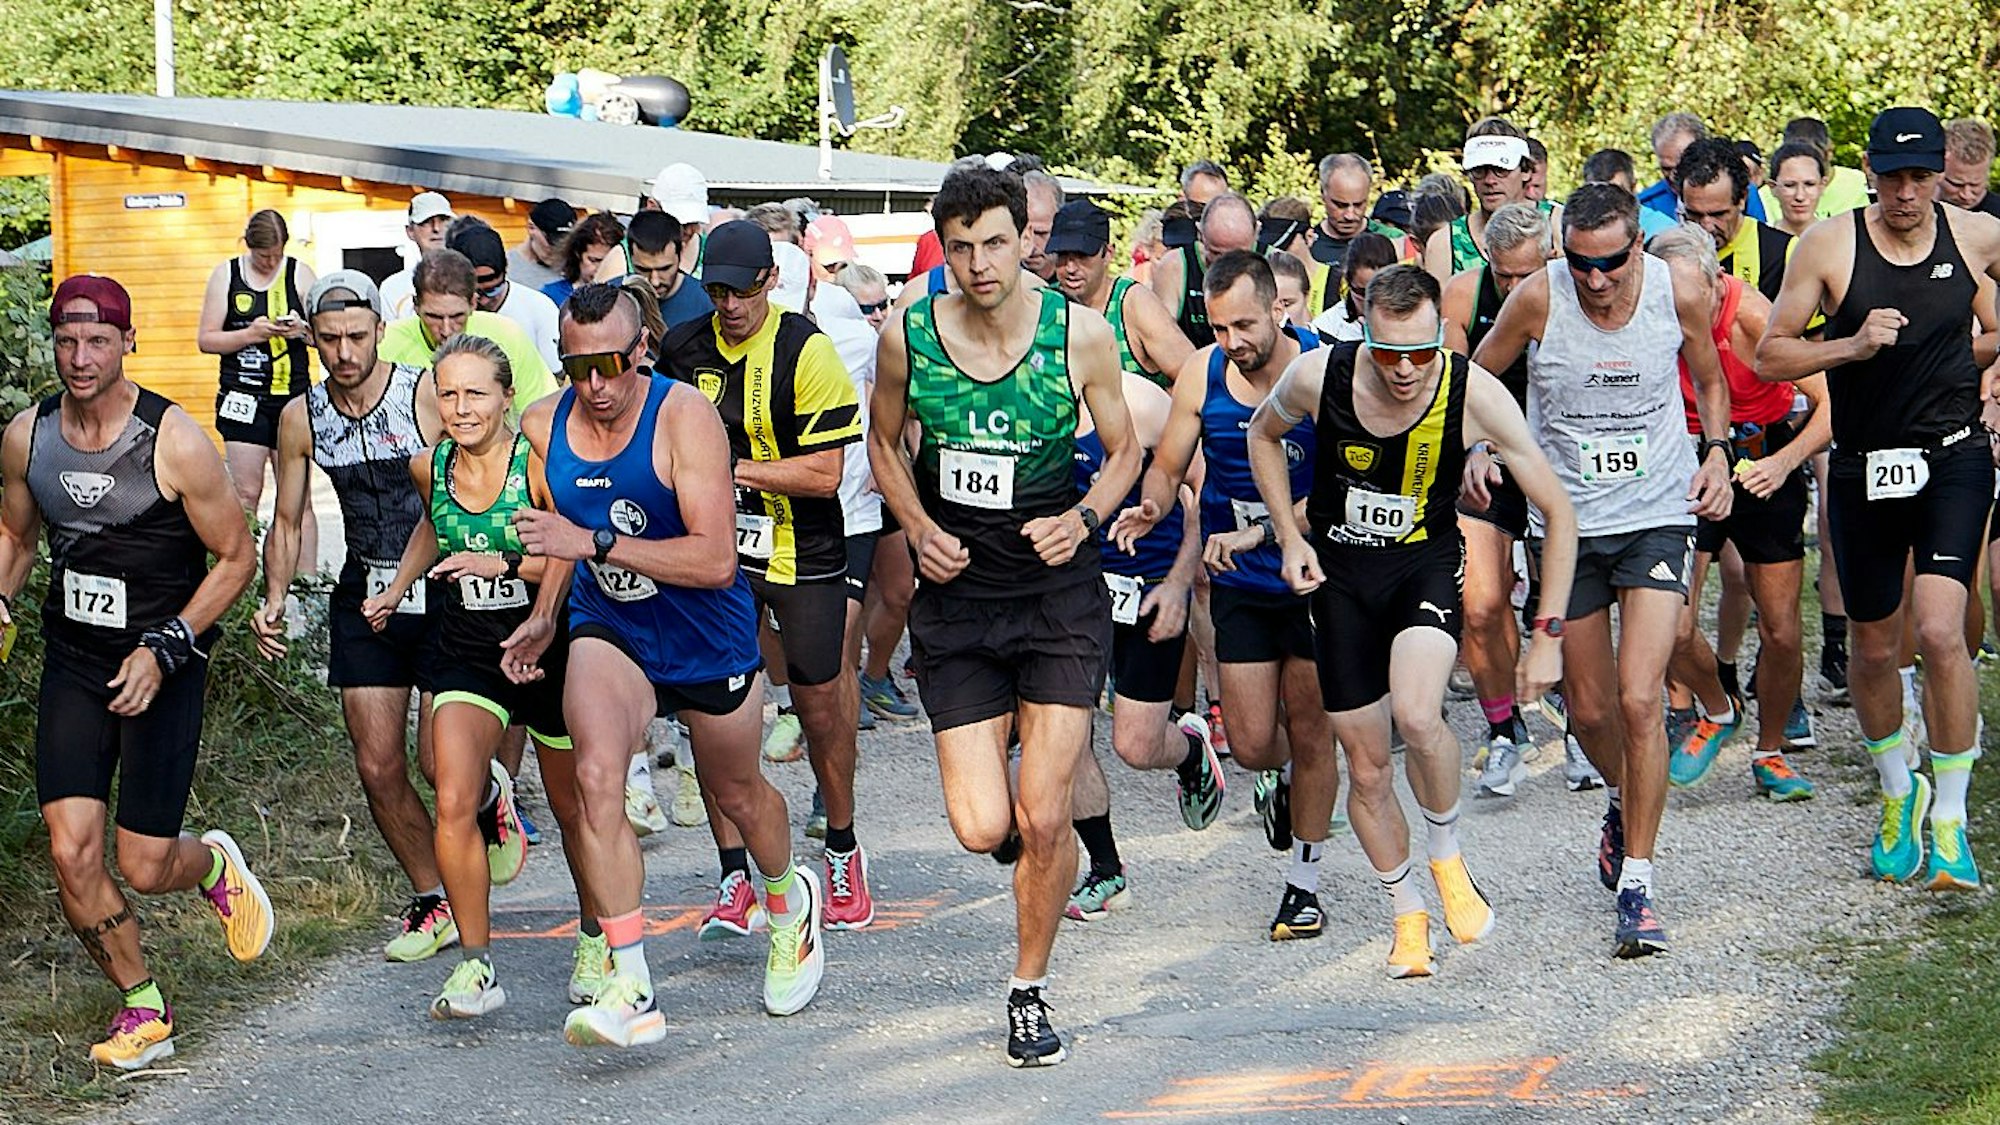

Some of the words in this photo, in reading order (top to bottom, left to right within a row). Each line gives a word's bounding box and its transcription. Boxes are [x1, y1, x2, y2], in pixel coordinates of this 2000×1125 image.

[226, 401, 250, 416] 133
[969, 409, 1010, 435] LC
[1349, 449, 1372, 465] TuS
[1592, 451, 1639, 473] 159
[576, 478, 604, 487] CRAFT
[952, 468, 999, 495] 184
[1876, 464, 1917, 488] 201
[1357, 505, 1403, 528] 160
[464, 532, 489, 549] LC
[379, 580, 416, 602] 24
[470, 577, 514, 600] 175
[599, 569, 641, 592] 122
[73, 588, 115, 615] 172
